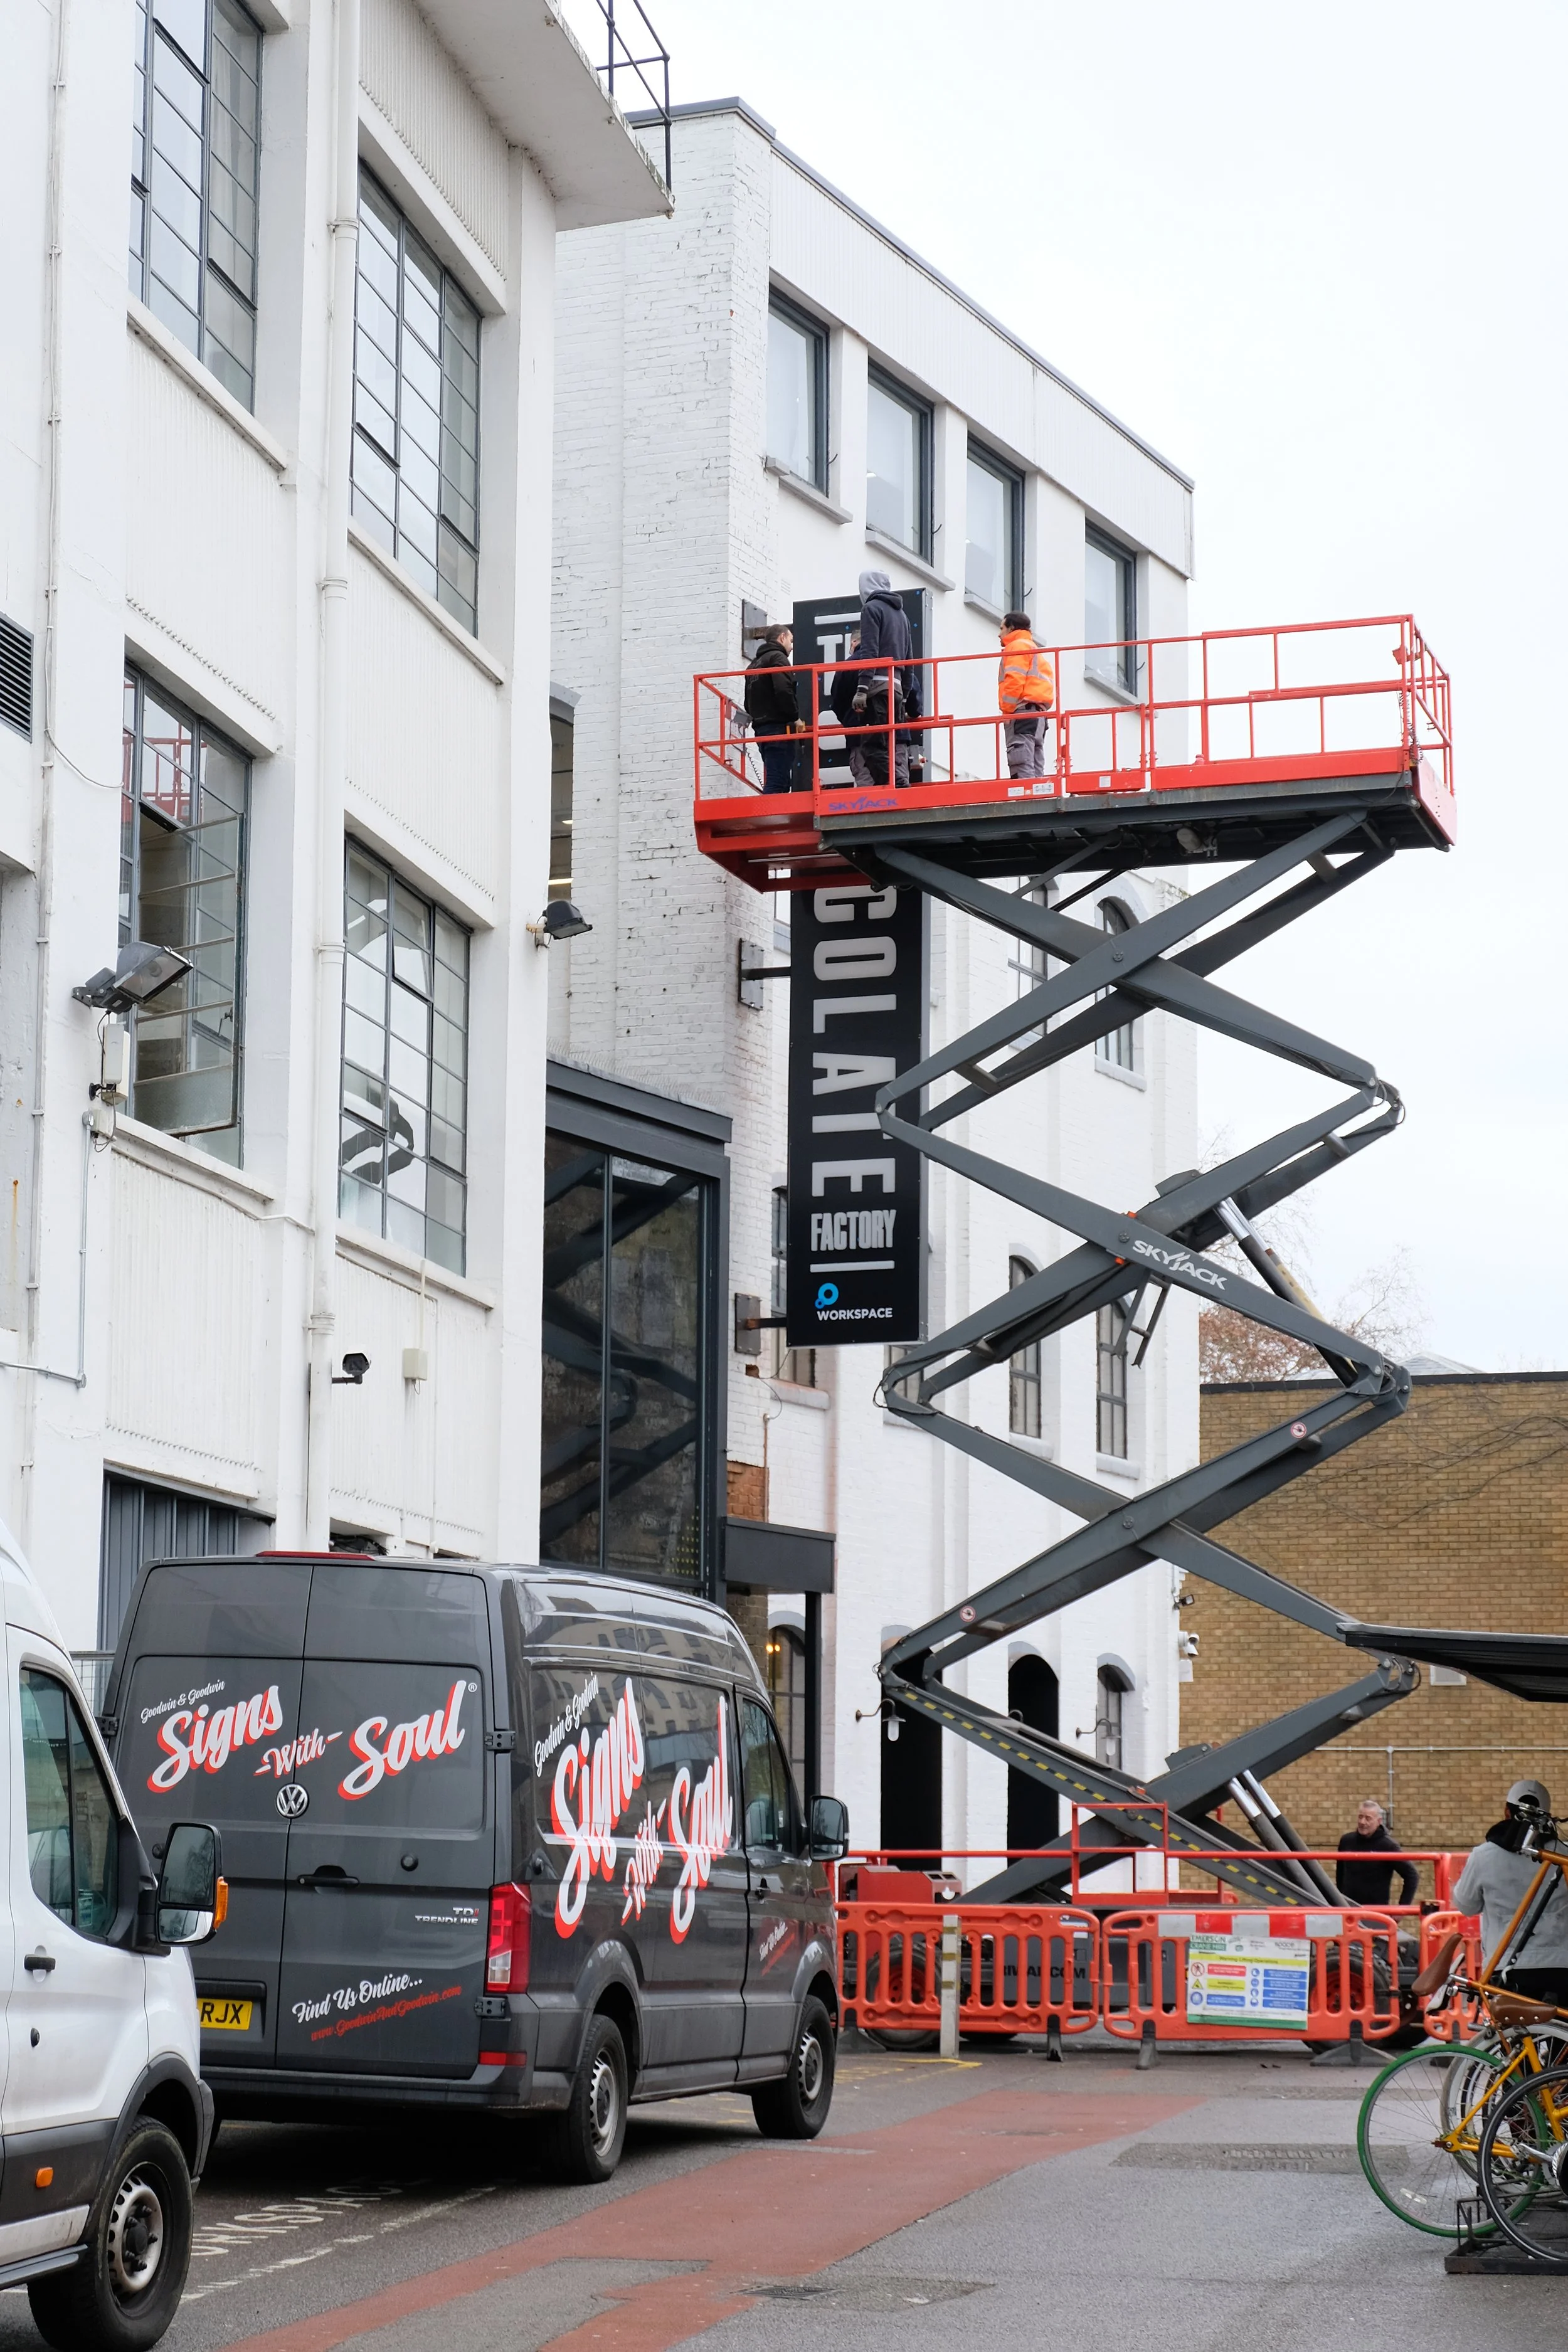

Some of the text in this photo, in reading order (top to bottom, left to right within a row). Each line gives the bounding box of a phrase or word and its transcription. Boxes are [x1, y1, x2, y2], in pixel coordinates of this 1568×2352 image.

[829, 796, 899, 812] SKYJACK
[811, 1209, 897, 1251] FACTORY
[1132, 1239, 1228, 1290] SKYJACK
[817, 1308, 893, 1321] WORKSPACE
[140, 1679, 225, 1724] Goodwin & Goodwin
[147, 1685, 283, 1793] Signs
[535, 1671, 599, 1777] Goodwin & Goodwin
[551, 1677, 644, 1939] Signs
[668, 1695, 733, 1944] Soul
[415, 1915, 479, 1925] TRENDLINE
[200, 2002, 244, 2025] RJX
[292, 1993, 331, 2023] Find
[332, 1987, 358, 2011] Us
[310, 1985, 462, 2042] www.GoodwinAndGoodwin.com
